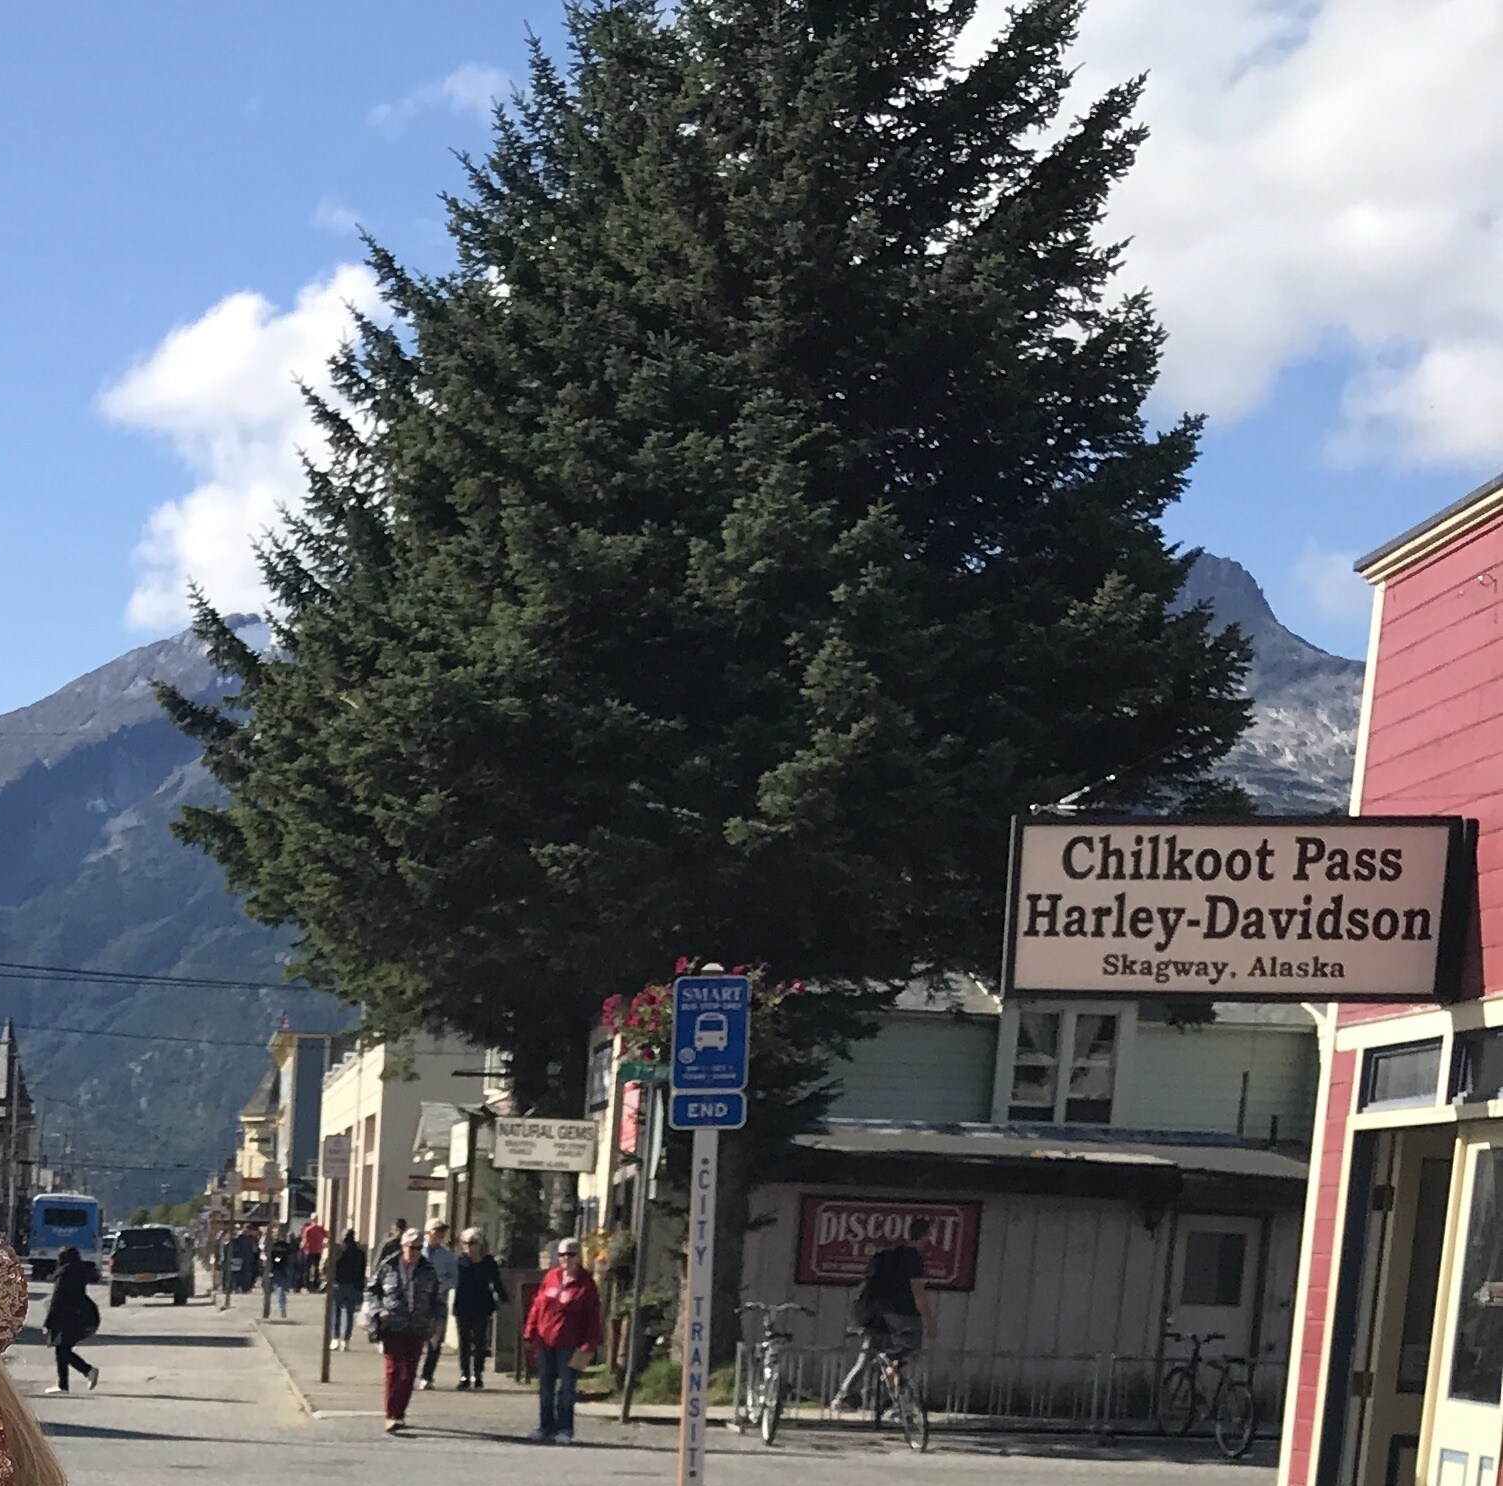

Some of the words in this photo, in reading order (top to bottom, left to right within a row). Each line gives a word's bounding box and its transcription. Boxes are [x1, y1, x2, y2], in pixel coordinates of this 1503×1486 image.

[1062, 833, 1275, 882] Chilkoot
[1292, 836, 1403, 882] Pass
[1023, 892, 1433, 952] Harley-Davidson
[1102, 953, 1236, 985] Skagway,
[1247, 956, 1345, 979] Alaska
[681, 987, 743, 1002] SMART
[687, 1102, 728, 1118] END
[499, 1123, 555, 1140] NATURAL
[558, 1125, 595, 1141] GEMS
[694, 1168, 710, 1266] CITY
[688, 1296, 704, 1467] TRANSIT
